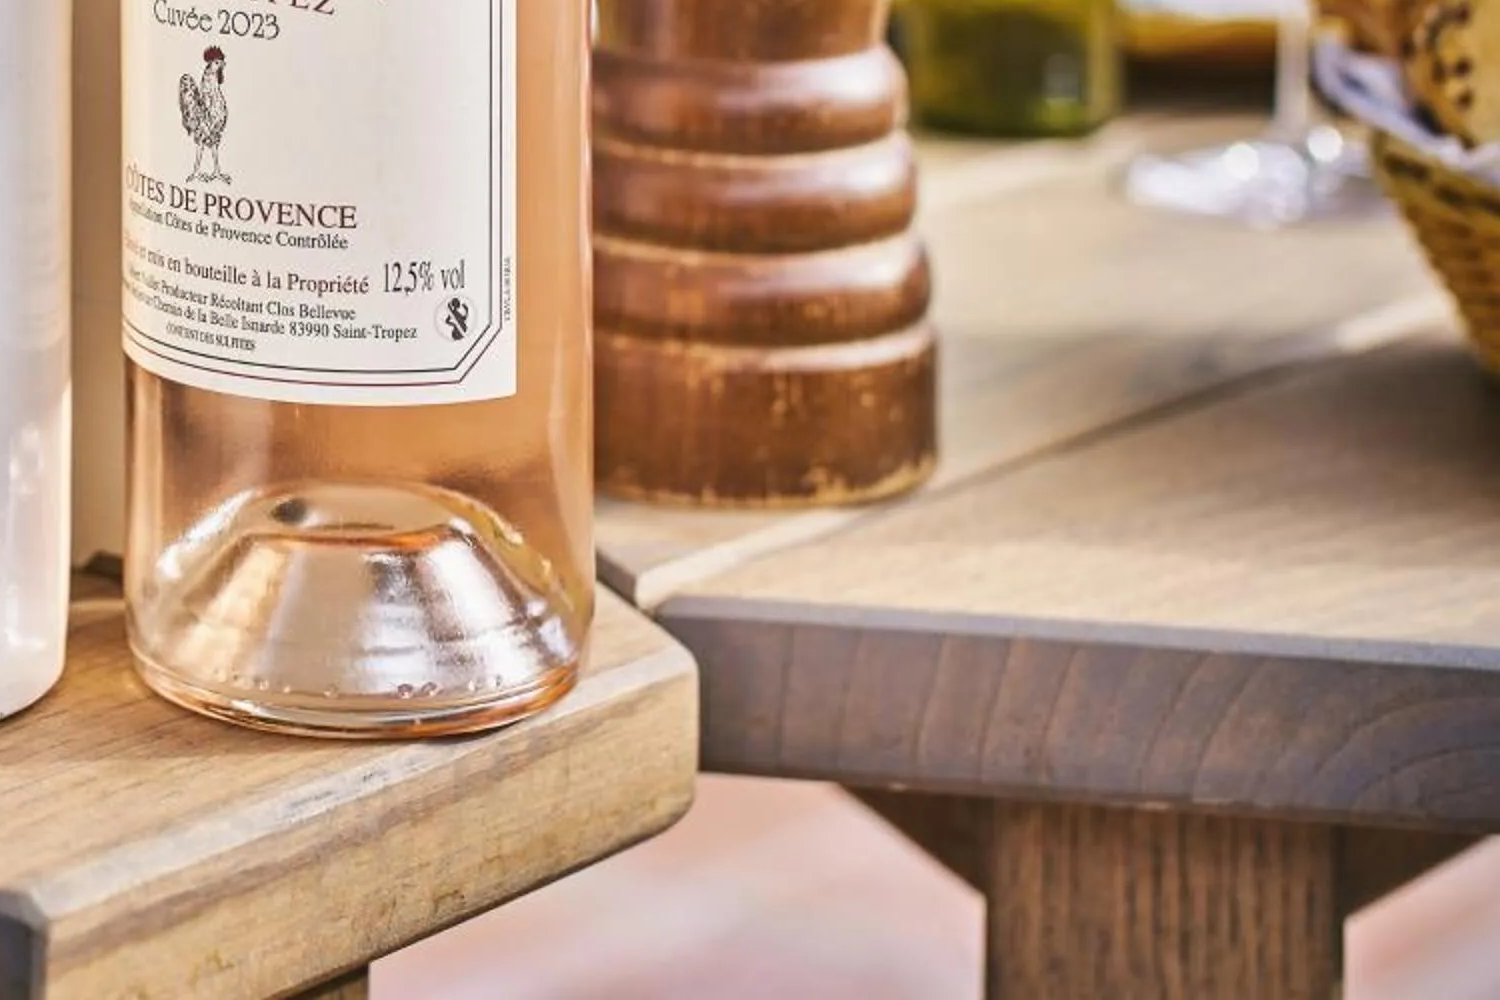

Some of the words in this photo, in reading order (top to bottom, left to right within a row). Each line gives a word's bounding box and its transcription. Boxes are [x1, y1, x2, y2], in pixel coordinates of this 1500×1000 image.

[217, 9, 280, 41] 2023
[170, 184, 197, 213] DE
[203, 192, 357, 230] PROVENCE
[165, 211, 192, 233] Côtes
[196, 220, 208, 236] de
[211, 221, 273, 246] Provence
[276, 229, 350, 249] Contrôlée
[167, 257, 181, 273] en
[185, 256, 248, 286] bouteille
[251, 269, 262, 288] à
[266, 271, 281, 289] la
[287, 273, 370, 298] Propriété
[441, 258, 465, 291] vol
[184, 305, 195, 321] de
[197, 308, 207, 324] la
[210, 312, 239, 329] Belle
[241, 316, 285, 335] Isnarde
[289, 321, 329, 338] 83990
[333, 322, 418, 343] Saint-Tropez
[210, 292, 263, 311] Récoltant
[266, 301, 295, 317] Clos
[299, 303, 357, 321] Bellevue
